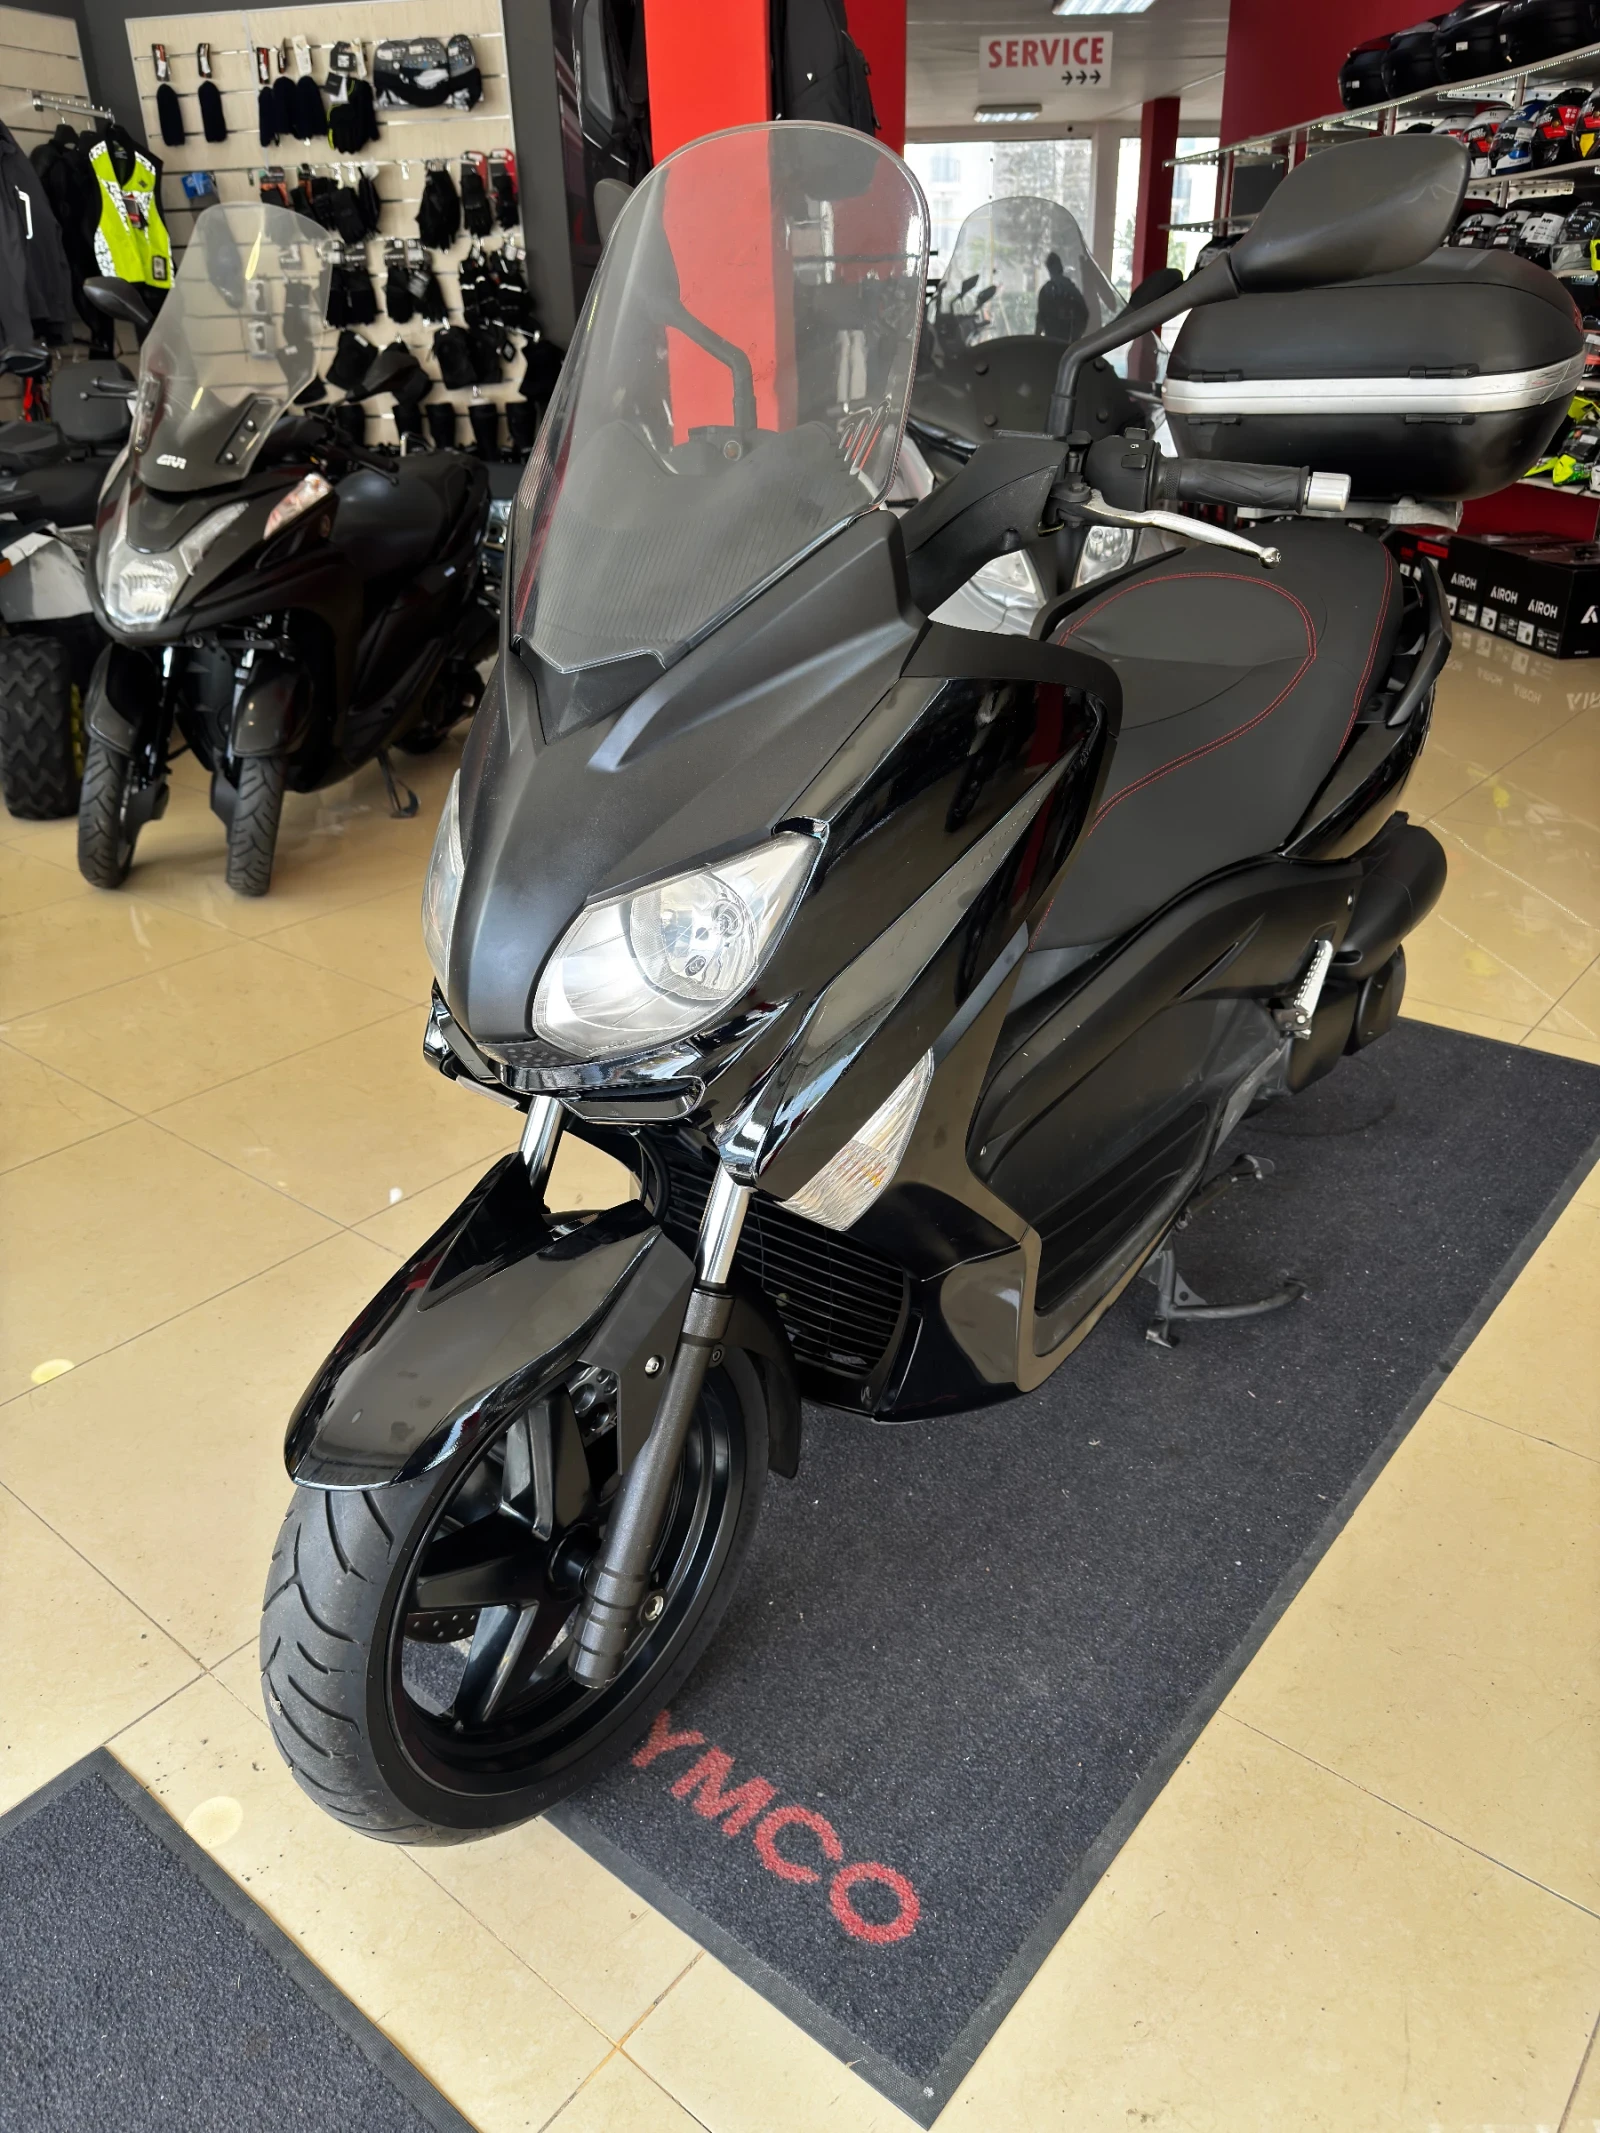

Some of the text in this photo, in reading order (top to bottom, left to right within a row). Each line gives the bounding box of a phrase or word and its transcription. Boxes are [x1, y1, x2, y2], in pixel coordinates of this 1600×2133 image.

[988, 37, 1104, 69] SERVICE
[1451, 572, 1478, 591] AIROH
[1490, 586, 1518, 605] AIROH
[1528, 599, 1559, 619] AIROH
[632, 1709, 921, 1945] YMCO
